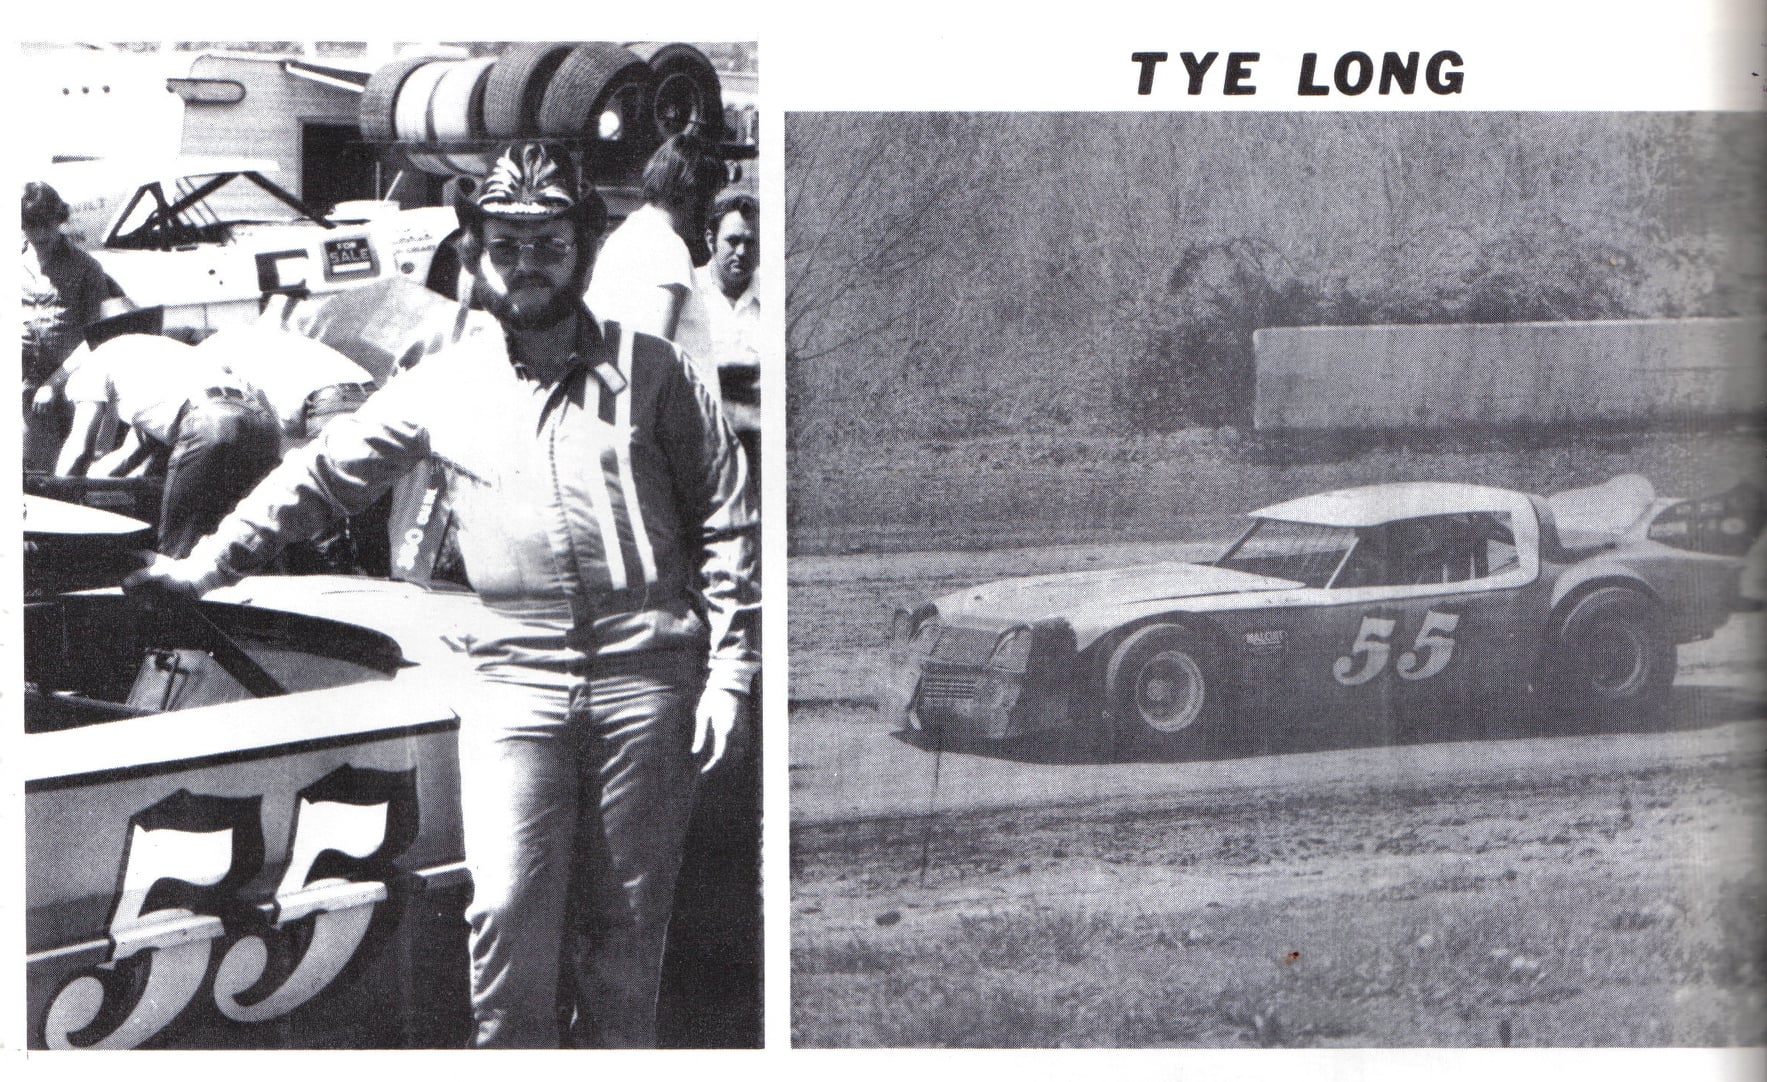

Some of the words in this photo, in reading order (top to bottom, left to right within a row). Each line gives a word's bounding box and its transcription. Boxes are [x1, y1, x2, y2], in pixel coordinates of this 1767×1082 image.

[1131, 51, 1260, 95] TYE
[1298, 50, 1464, 96] LONG
[330, 248, 370, 263] SALE
[337, 241, 357, 249] FOR
[1333, 610, 1459, 685] 55
[45, 797, 390, 1050] 55
